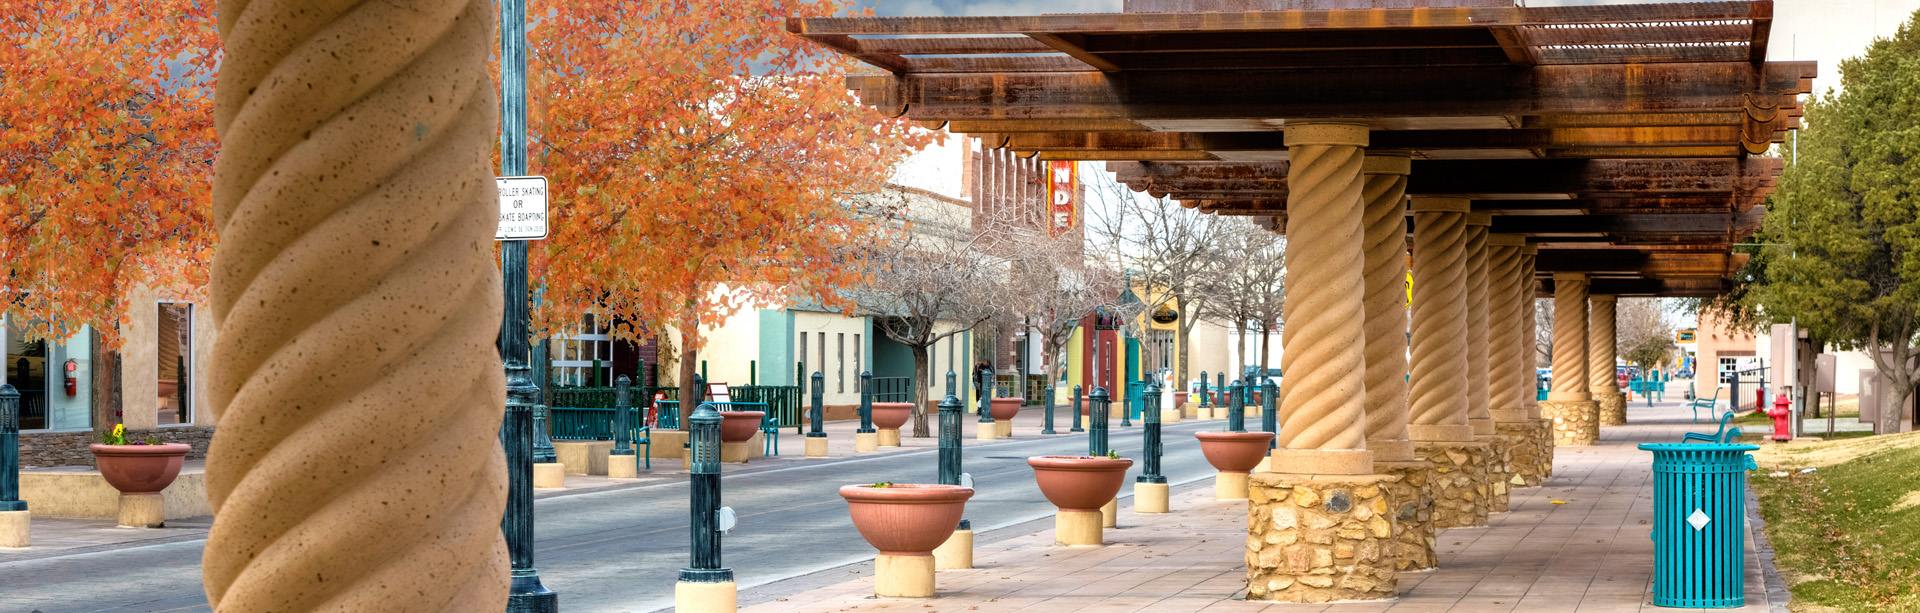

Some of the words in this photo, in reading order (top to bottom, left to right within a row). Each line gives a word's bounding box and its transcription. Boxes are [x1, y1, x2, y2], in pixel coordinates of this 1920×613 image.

[498, 188, 519, 196] ROLLER
[522, 187, 544, 196] SKATING
[513, 200, 523, 208] OR
[499, 212, 515, 222] SKATE
